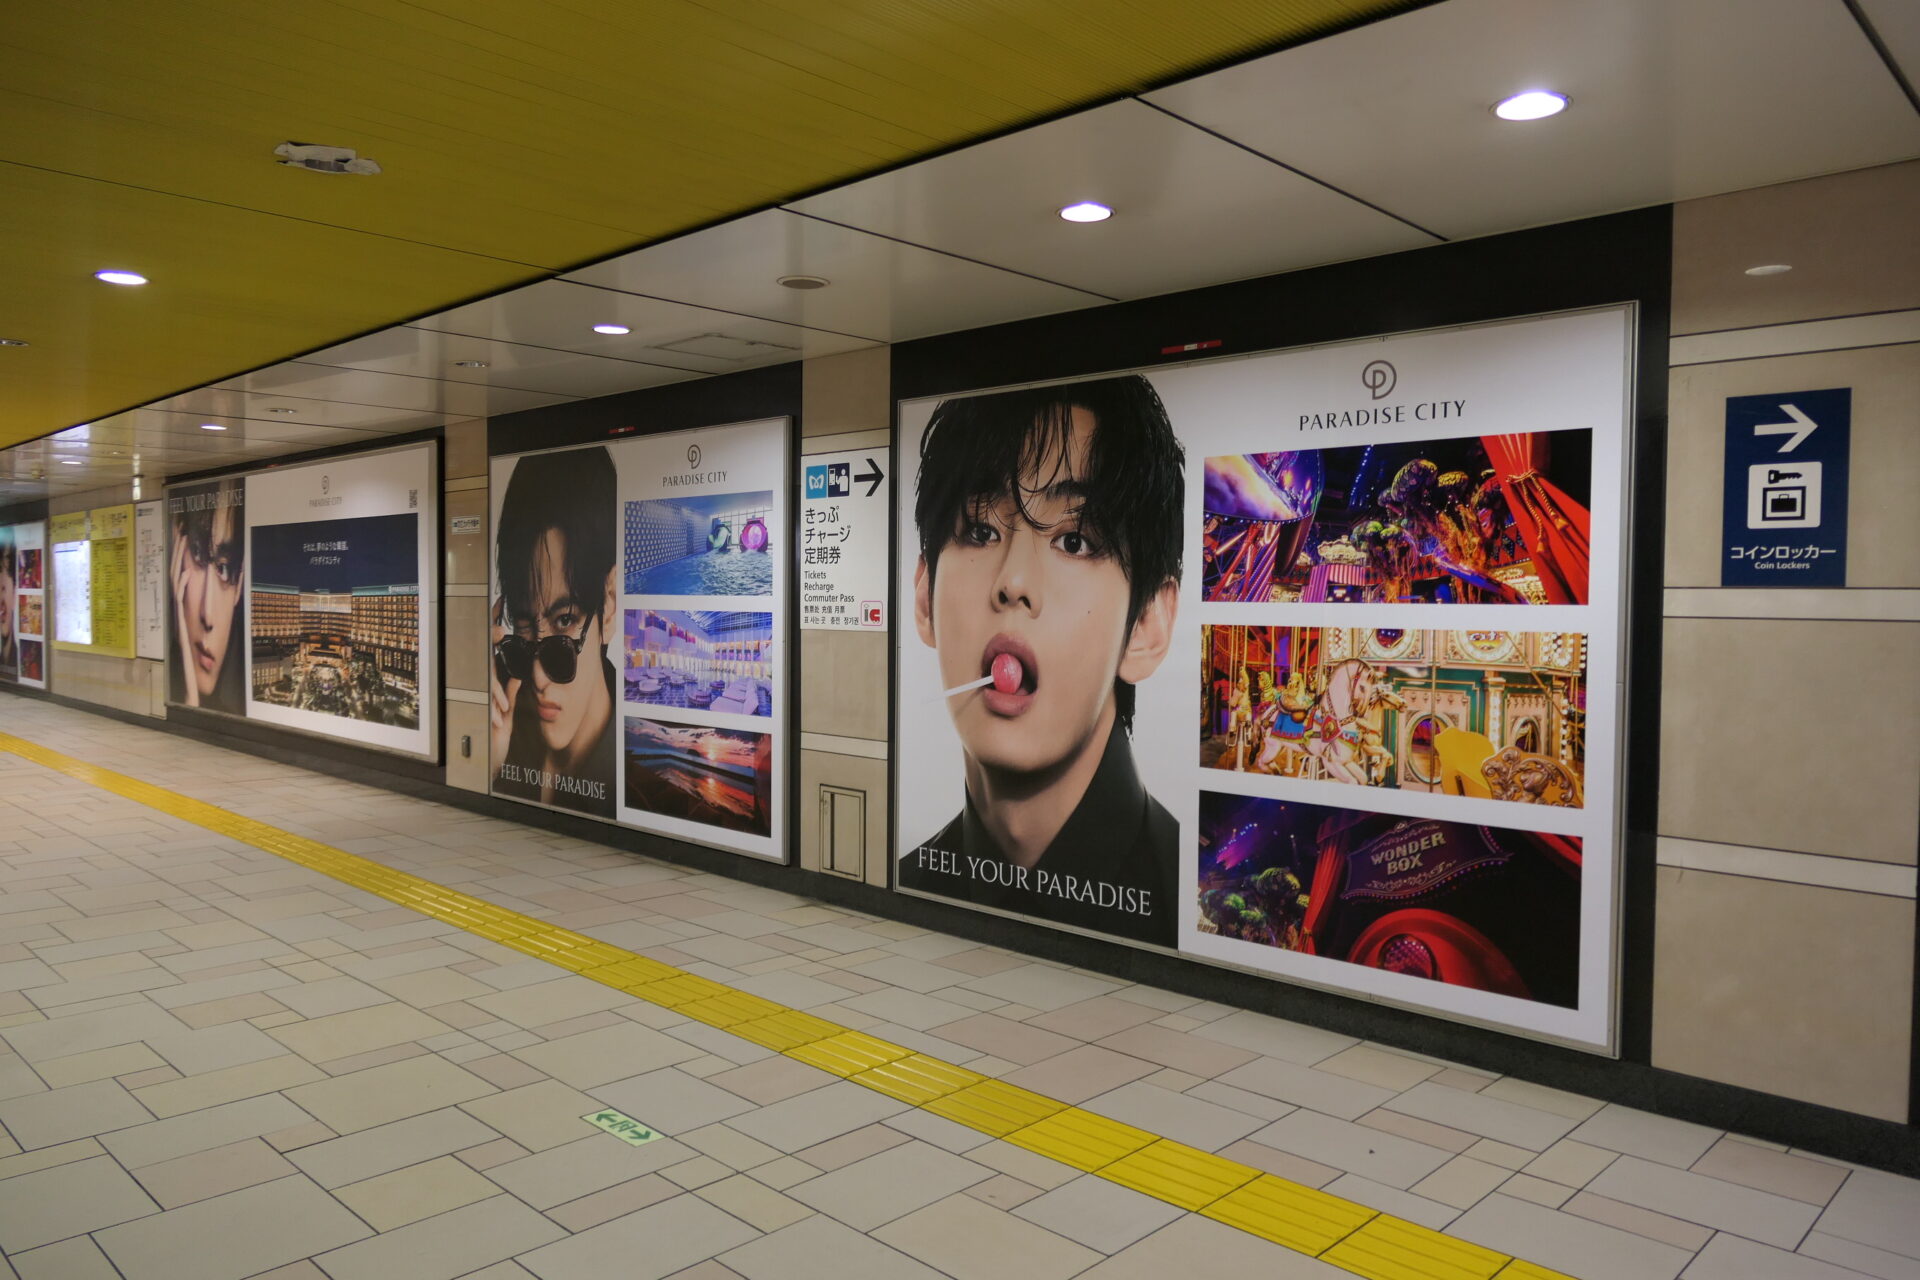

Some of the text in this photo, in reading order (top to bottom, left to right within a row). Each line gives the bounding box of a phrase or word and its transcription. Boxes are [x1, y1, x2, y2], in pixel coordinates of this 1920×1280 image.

[1299, 399, 1466, 431] PARADISE CITY
[662, 470, 727, 488] PARADISE CITY
[804, 505, 840, 525] きっぷ
[804, 525, 851, 545] チャージ
[804, 546, 841, 565] 定期券
[1730, 544, 1837, 560] コインロッカー
[804, 570, 827, 579] Tickets
[1754, 561, 1811, 570] Coin Lockers
[804, 582, 834, 592] Recharge
[804, 593, 855, 602] Commuter Pass
[501, 763, 606, 800] FEEL YOUR PARADISE
[1371, 832, 1446, 865] WONDER
[1387, 853, 1423, 875] BOX
[917, 846, 1152, 916] FEEL YOUR PARADISE
